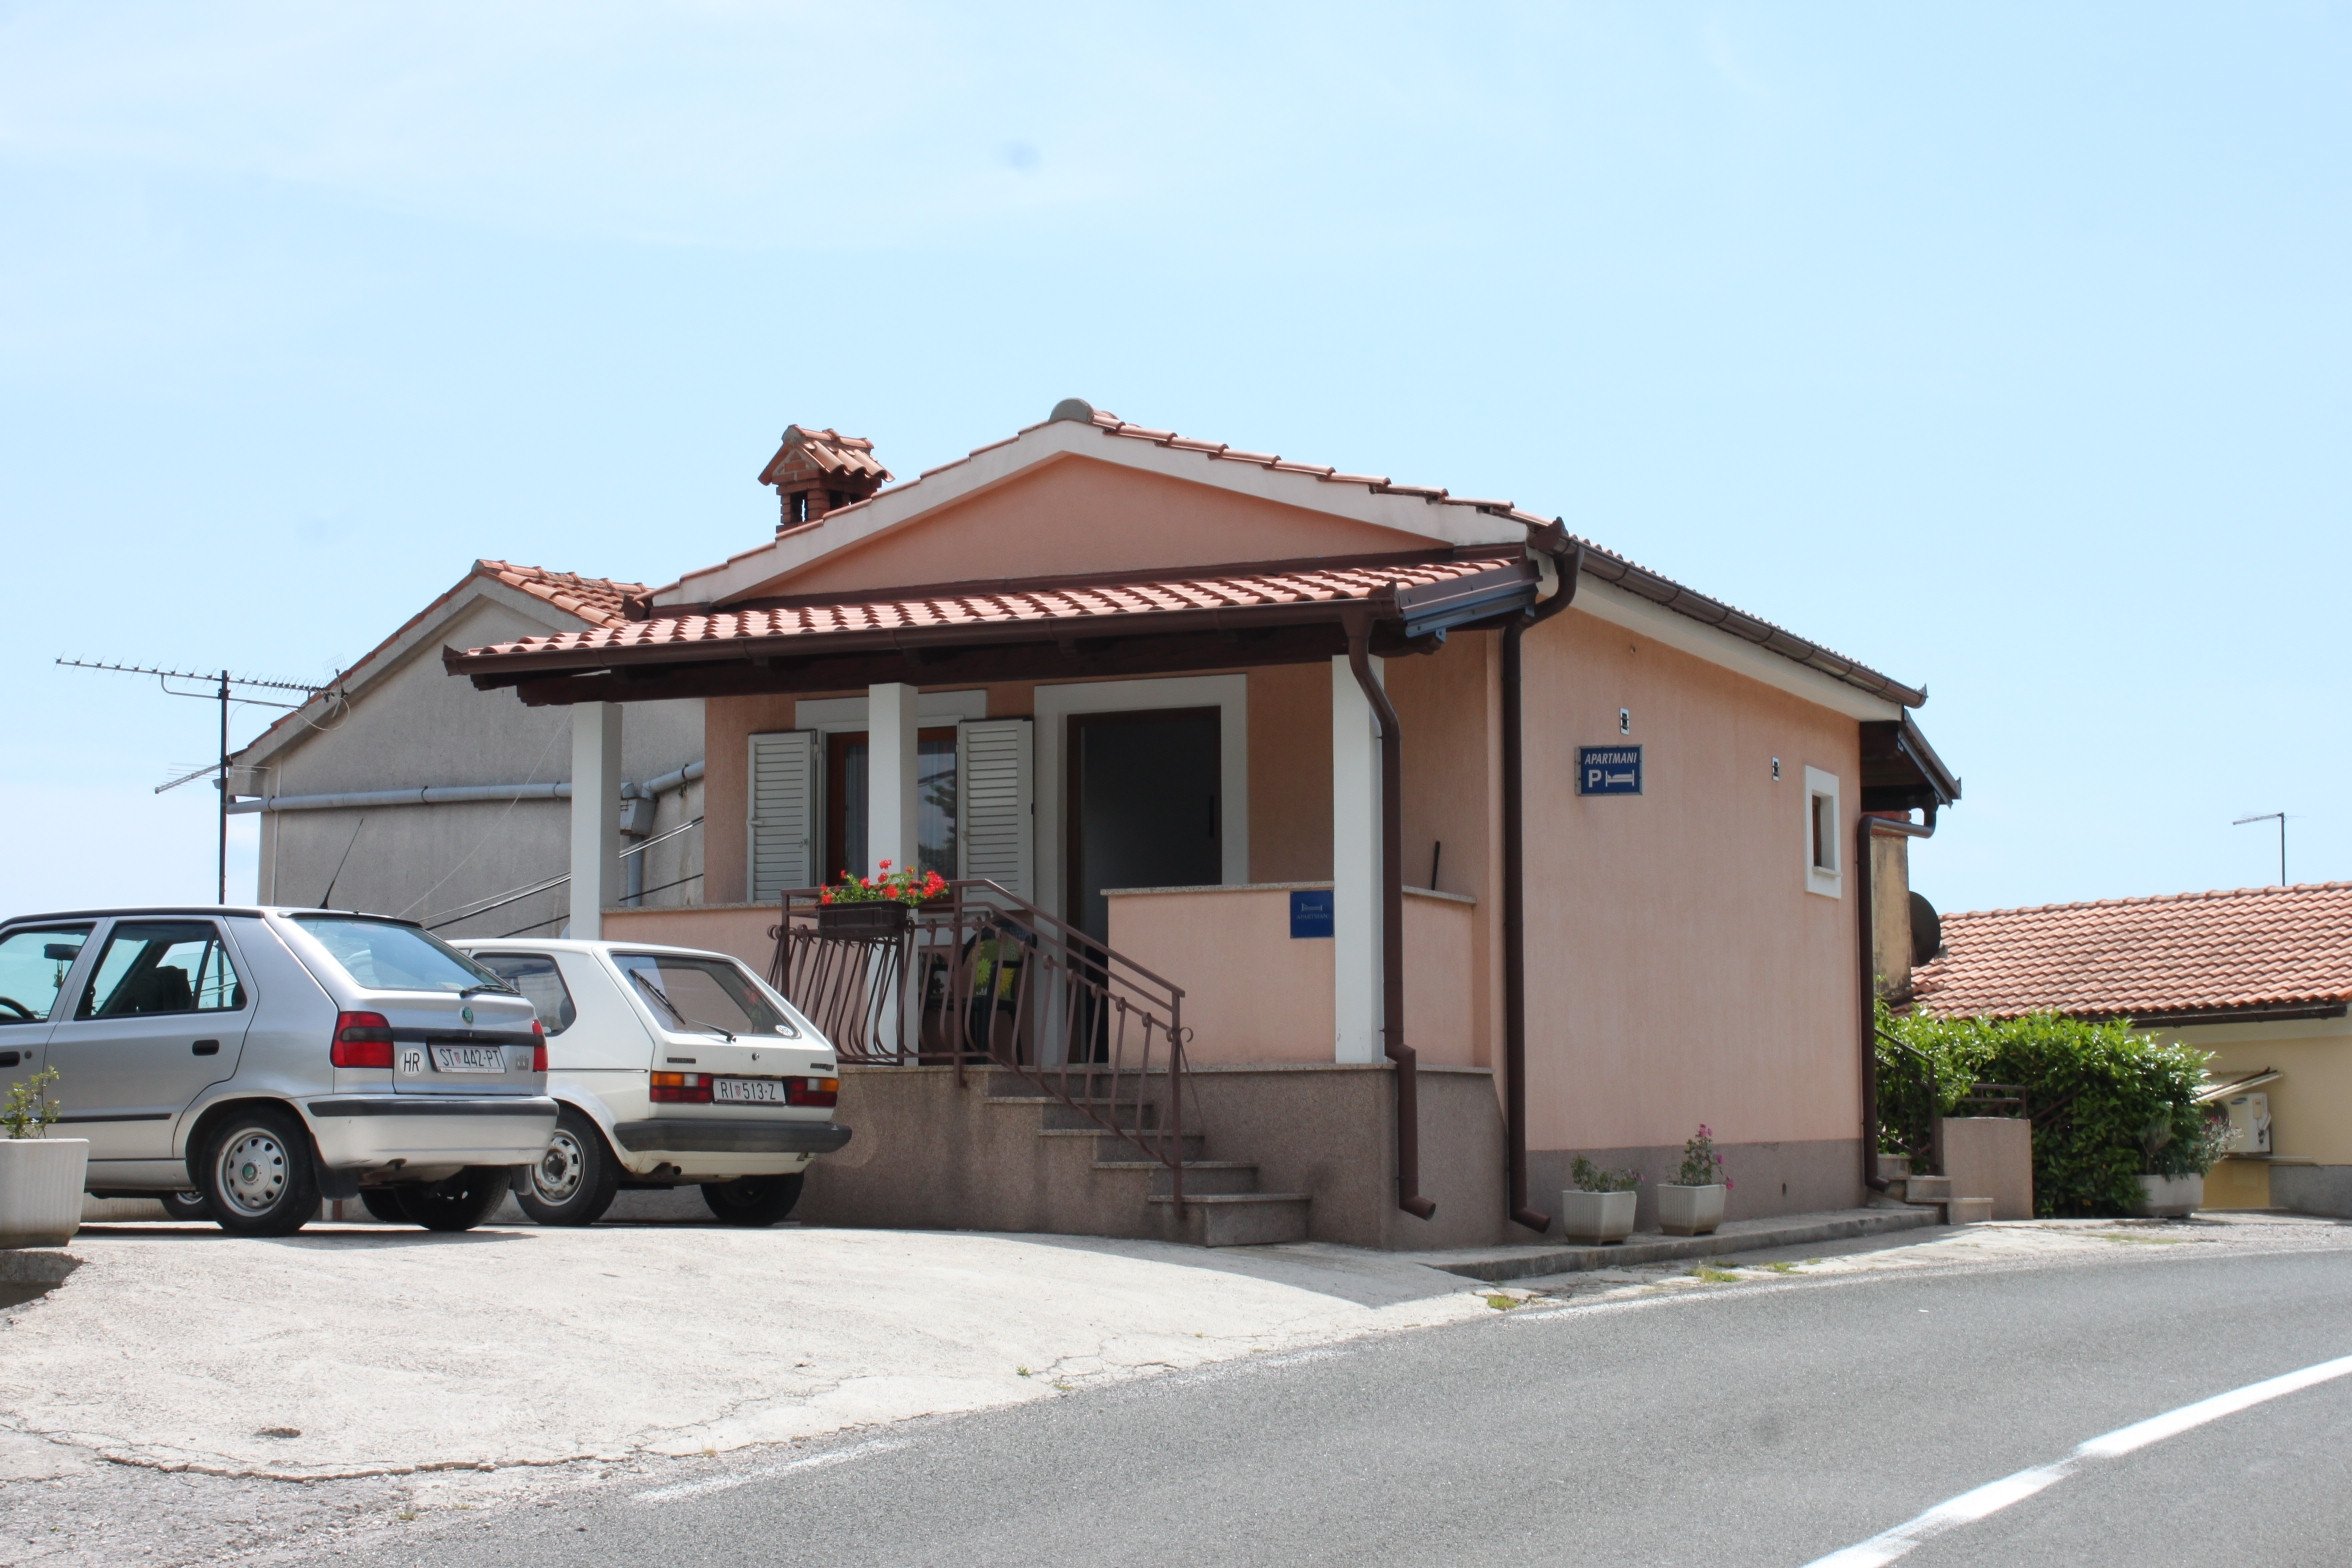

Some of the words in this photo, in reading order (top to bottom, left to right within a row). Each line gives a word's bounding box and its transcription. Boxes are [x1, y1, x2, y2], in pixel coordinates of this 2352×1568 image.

[1584, 752, 1637, 765] APARTMANI
[1588, 769, 1602, 788] P
[403, 1052, 420, 1072] HR
